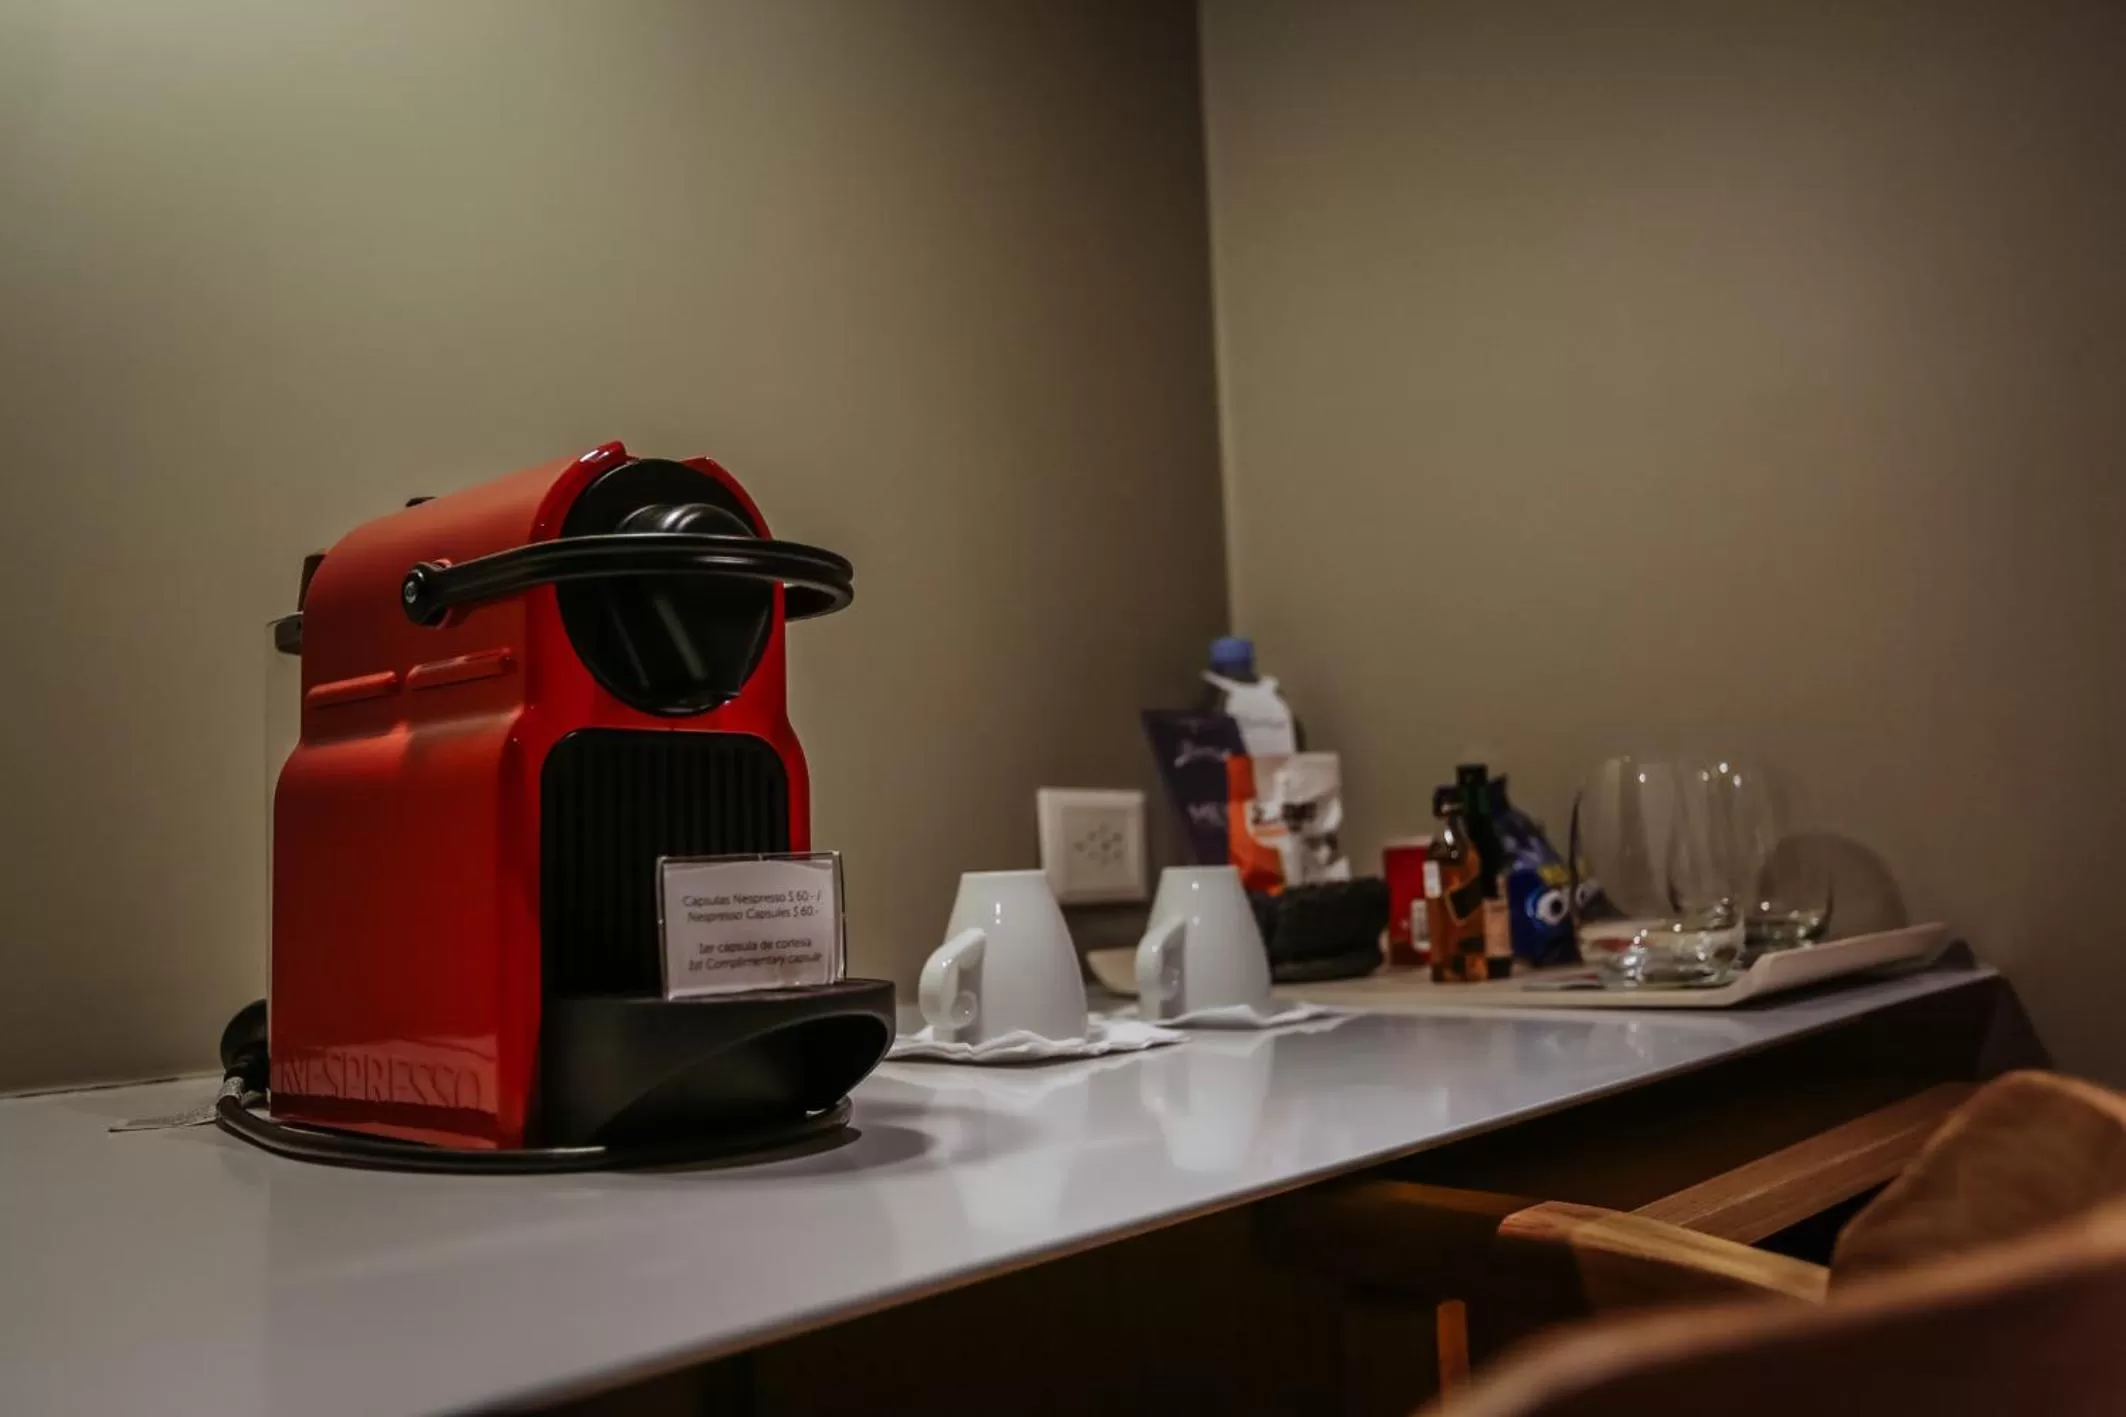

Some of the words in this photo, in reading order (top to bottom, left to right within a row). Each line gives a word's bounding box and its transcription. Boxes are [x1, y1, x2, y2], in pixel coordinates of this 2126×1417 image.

[733, 893, 786, 905] Nespresso
[687, 911, 743, 924] Nespresso
[745, 908, 791, 920] Capsules
[760, 940, 773, 951] de
[706, 955, 785, 971] Complimentary
[787, 952, 823, 964] capsule
[279, 1052, 480, 1110] NESPRESSO
